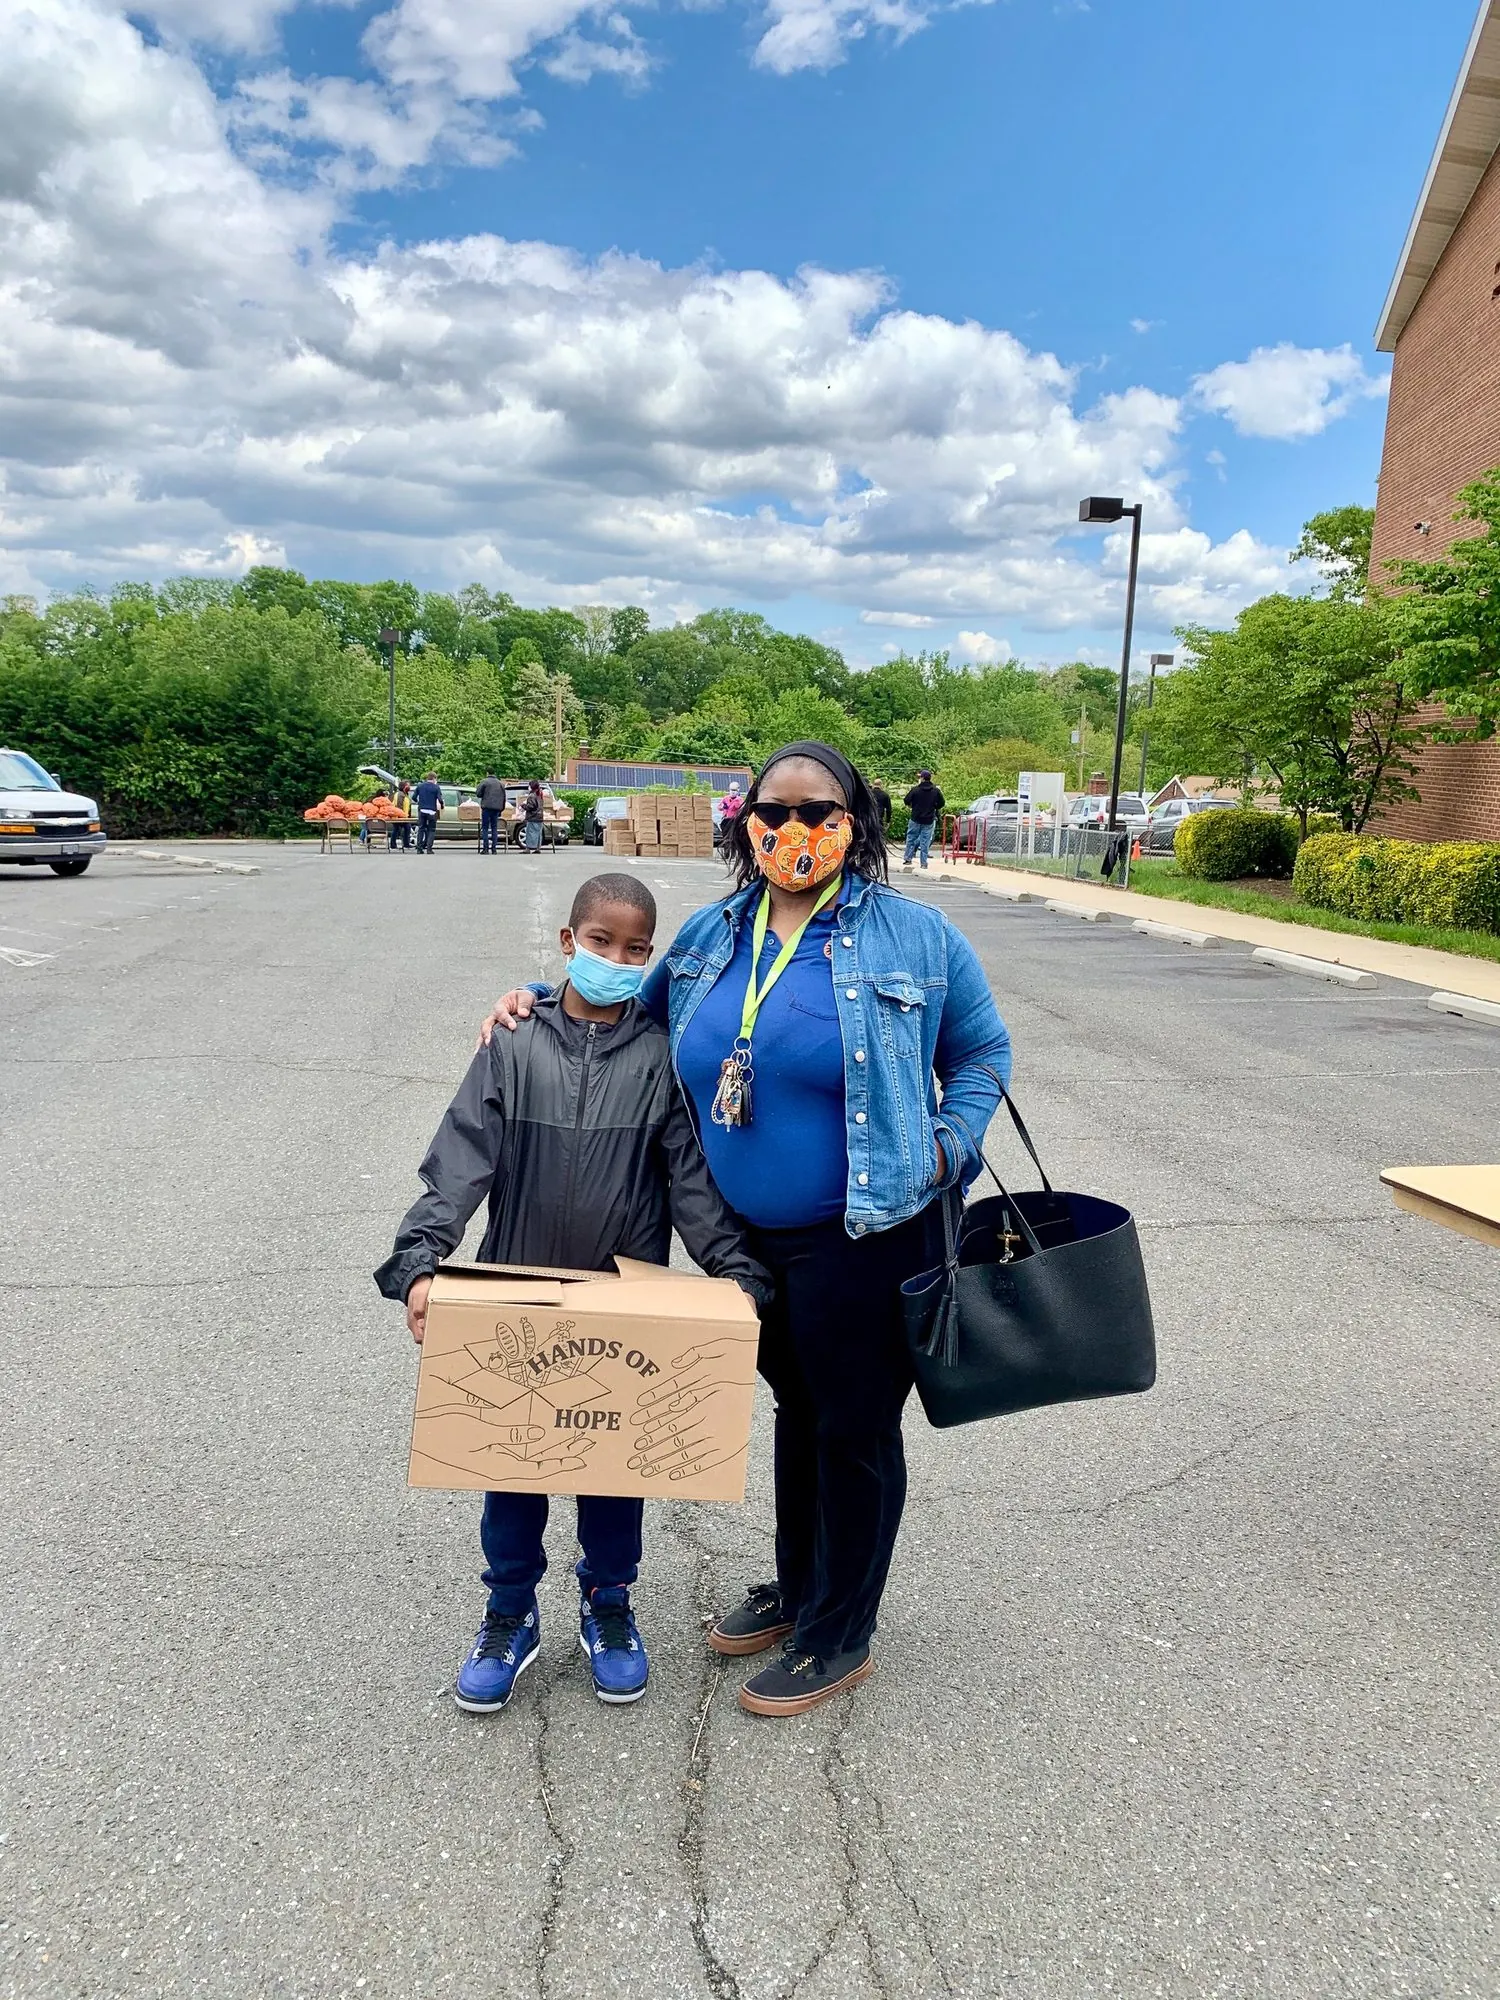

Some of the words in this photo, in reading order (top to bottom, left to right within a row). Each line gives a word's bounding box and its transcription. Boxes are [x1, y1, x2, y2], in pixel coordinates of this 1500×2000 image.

[527, 1338, 624, 1375] HANDS
[625, 1350, 661, 1378] OF
[554, 1408, 622, 1431] HOPE
